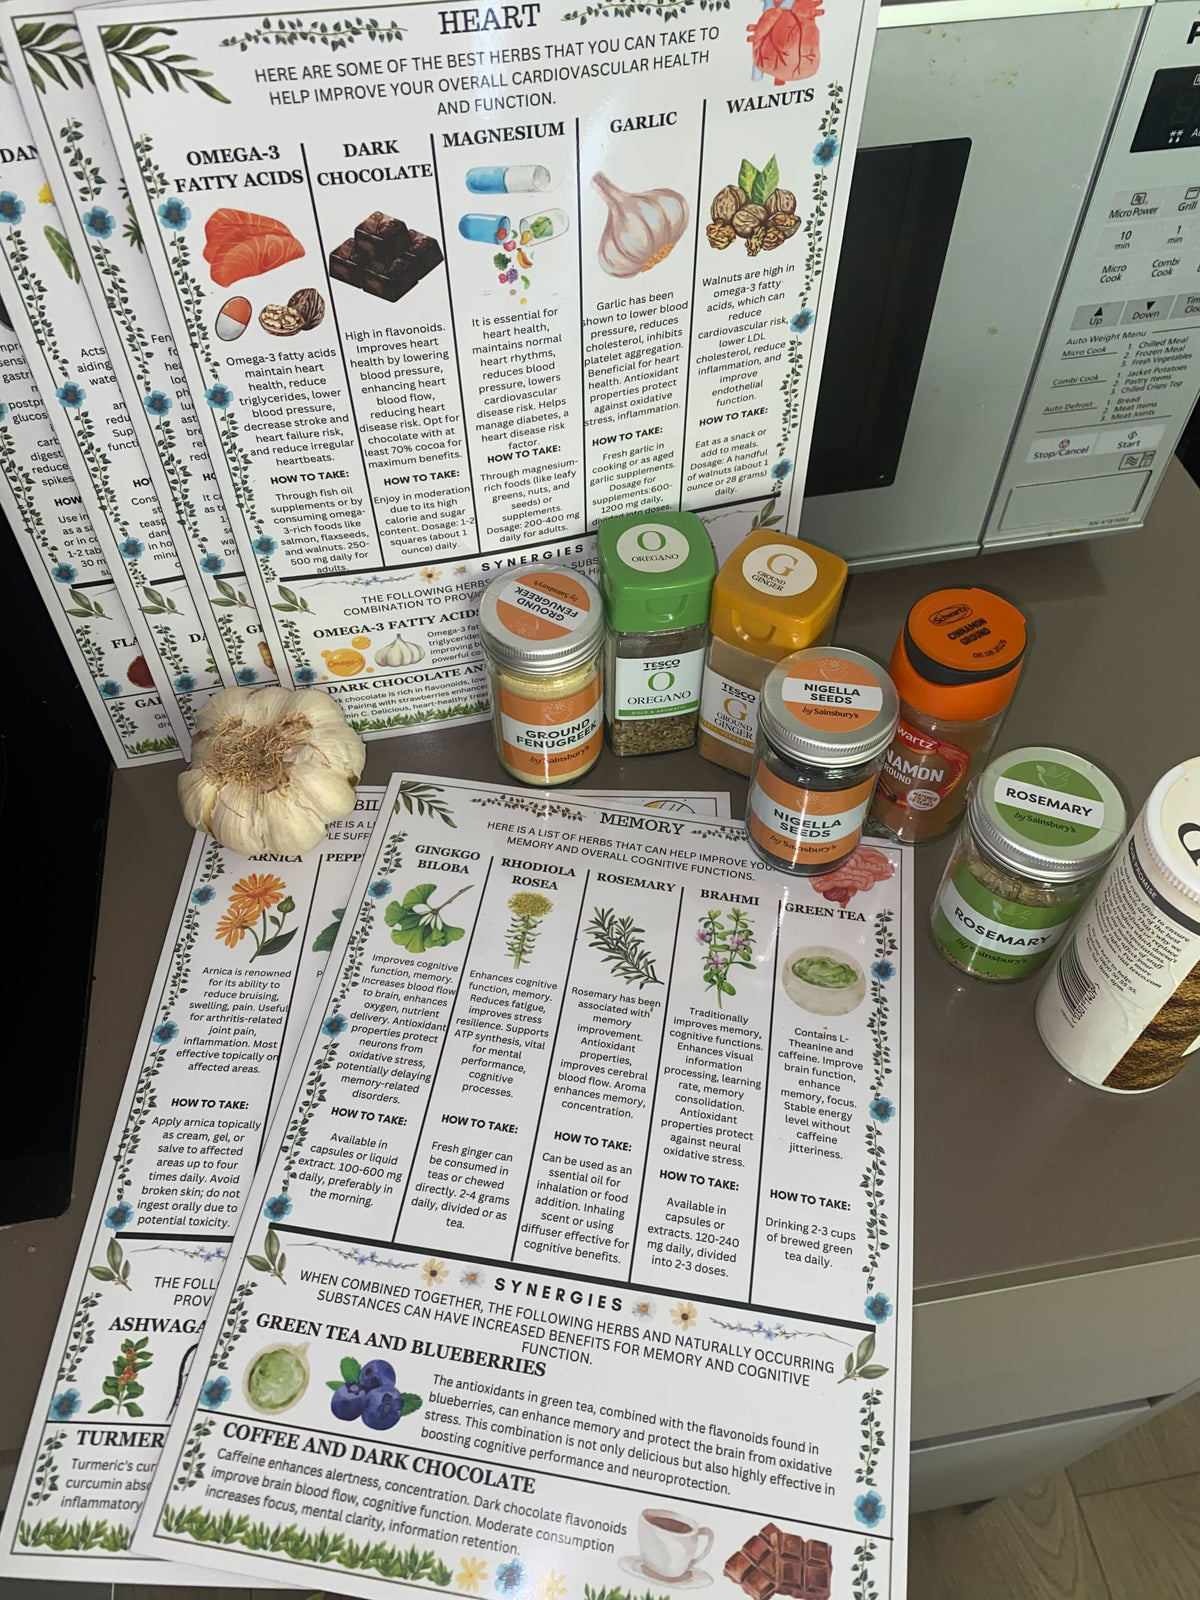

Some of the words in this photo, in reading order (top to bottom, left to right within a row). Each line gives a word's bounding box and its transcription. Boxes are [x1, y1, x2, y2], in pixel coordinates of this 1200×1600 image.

[437, 3, 540, 34] HEART
[255, 66, 297, 82] HERE
[302, 64, 332, 79] ARE
[336, 60, 383, 77] SOME
[387, 58, 407, 73] OF
[411, 55, 443, 70] THE
[447, 51, 484, 68] BEST
[490, 46, 540, 63] HERBS
[544, 41, 584, 58] THAT
[588, 38, 619, 54] YOU
[624, 34, 655, 50] CAN
[659, 29, 695, 46] TAKE
[699, 26, 719, 40] TO
[726, 88, 814, 113] WALNUTS
[610, 111, 677, 132] GARLIC
[442, 121, 564, 147] MAGNESIUM
[186, 145, 280, 165] OMEGA-3
[343, 139, 399, 157] DARK
[174, 174, 237, 192] FATTY
[244, 169, 303, 187] ACIDS
[317, 163, 432, 186] CHOCOLATE
[1109, 209, 1132, 219] Micro
[1133, 206, 1158, 217] Power
[1178, 201, 1198, 212] Grill
[1120, 230, 1132, 240] 10
[1176, 225, 1181, 234] 1
[1114, 242, 1130, 250] min
[1167, 237, 1183, 245] min
[1102, 265, 1127, 274] Micro
[1152, 257, 1181, 268] Combi
[702, 273, 742, 286] Walnuts
[744, 270, 760, 279] are
[763, 265, 783, 277] high
[786, 263, 794, 272] in
[1100, 273, 1123, 284] Cook
[1151, 268, 1174, 277] Cook
[1089, 317, 1103, 325] Up
[1132, 311, 1160, 320] Down
[345, 330, 370, 341] High
[372, 329, 382, 337] in
[385, 323, 445, 336] flavonoids.
[1065, 338, 1087, 346] Auto
[1090, 333, 1120, 344] Weight
[1121, 331, 1147, 339] Menu
[1138, 340, 1166, 349] Chilled
[1167, 336, 1189, 345] Meal
[81, 346, 105, 358] Acts
[1062, 349, 1085, 358] Micro
[1087, 346, 1107, 354] Cook
[1131, 358, 1151, 366] Fresh
[1153, 353, 1192, 364] Vegetables
[1153, 364, 1187, 373] Potatoes
[1053, 377, 1077, 386] Combi
[1079, 374, 1099, 382] Cook
[1043, 405, 1063, 413] Auto
[1064, 401, 1093, 410] Defrost
[1110, 412, 1131, 420] Meat
[1032, 445, 1090, 460] Stop/Cancel
[1117, 439, 1141, 449] Start
[41, 474, 74, 487] spikes
[637, 530, 666, 551] O
[482, 544, 584, 570] SYNERGIES
[631, 553, 679, 563] OREGANO
[766, 553, 799, 577] G
[752, 574, 784, 592] GINGER
[757, 570, 786, 586] GROUND
[515, 586, 579, 618] FENUGREEK
[517, 598, 565, 621] GROUND
[933, 606, 968, 625] Schwartz
[313, 621, 384, 639] OMEGA-3
[388, 617, 435, 630] FATTY
[947, 617, 987, 641] CINNAMON
[960, 627, 991, 645] GROUND
[643, 659, 681, 668] TESCO
[327, 681, 369, 695] DARK
[373, 668, 462, 689] CHOCOLATE
[648, 671, 675, 691] O
[804, 683, 860, 697] NIGELLA
[627, 690, 691, 705] OREGANO
[721, 681, 756, 701] TESCO
[810, 693, 852, 704] SEEDS
[723, 698, 747, 721] G
[802, 706, 814, 715] by
[814, 708, 859, 719] Sainsbury's
[526, 718, 589, 739] GROUND
[714, 718, 753, 741] GINGER
[716, 712, 753, 732] GROUND
[516, 720, 597, 748] FENUGREEK
[530, 756, 542, 765] by
[884, 762, 912, 785] ROUND
[1006, 787, 1093, 817] ROSEMARY
[599, 812, 685, 835] MEMORY
[773, 808, 842, 829] NIGELLA
[1014, 812, 1026, 821] by
[1027, 815, 1076, 833] Sainsbury's
[779, 822, 831, 838] SEEDS
[769, 834, 782, 845] by
[415, 844, 480, 860] GINGKGO
[417, 859, 469, 874] BILOBA
[501, 857, 575, 876] RHODIOLA
[511, 875, 557, 890] ROSEA
[596, 872, 675, 892] ROSEMARY
[700, 889, 759, 905] BRAHMI
[785, 902, 834, 917] GREEN
[838, 909, 866, 922] TEA
[955, 906, 1052, 946] ROSEMARY
[955, 937, 967, 949] by
[453, 1029, 473, 1038] ATP
[474, 1033, 520, 1047] synthesis,
[524, 1039, 545, 1049] vital
[171, 1098, 199, 1107] HOW
[201, 1099, 216, 1108] TO
[219, 1100, 248, 1109] TAKE:
[141, 1185, 177, 1195] broken
[180, 1187, 203, 1198] skin;
[206, 1188, 220, 1197] do
[222, 1190, 240, 1198] not
[765, 1216, 808, 1235] Drinking
[811, 1224, 827, 1235] 2-3
[830, 1229, 855, 1241] cups
[494, 1277, 622, 1311] SYNERGIES
[256, 1313, 322, 1336] GREEN
[325, 1324, 360, 1344] TEA
[363, 1332, 406, 1351] AND
[410, 1339, 546, 1376] BLUEBERRIES
[223, 1422, 300, 1449] COFFEE
[301, 1437, 346, 1457] AND
[350, 1444, 409, 1470] DARK
[412, 1456, 535, 1493] CHOCOLATE
[420, 1426, 471, 1448] boosting
[473, 1438, 526, 1456] cognitive
[528, 1449, 604, 1470] performance
[606, 1463, 629, 1475] and
[631, 1468, 731, 1494] neuroprotection.
